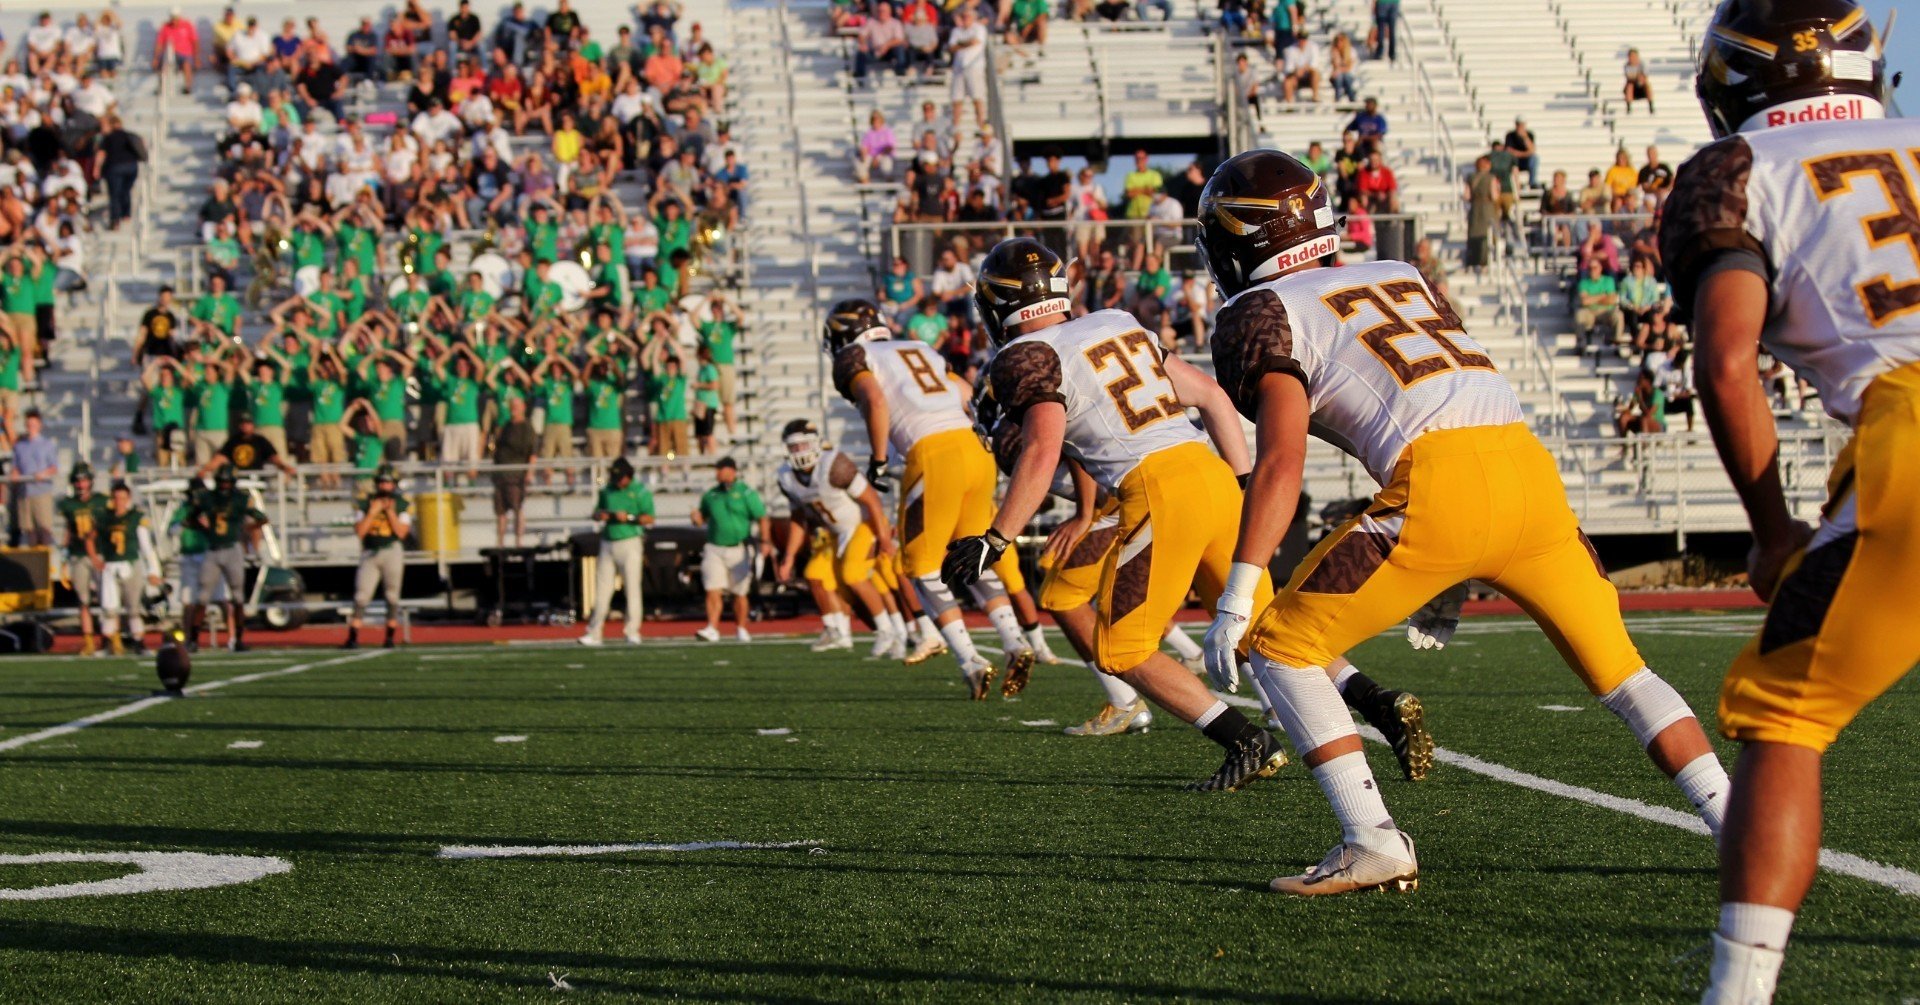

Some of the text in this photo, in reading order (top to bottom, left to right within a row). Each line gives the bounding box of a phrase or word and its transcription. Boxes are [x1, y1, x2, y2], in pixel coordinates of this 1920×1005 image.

[1792, 30, 1819, 52] 35
[1767, 99, 1863, 127] Riddell
[1277, 237, 1335, 270] Riddell
[1802, 147, 1920, 329] 3
[1026, 253, 1039, 262] 23
[1020, 300, 1065, 320] Riddell
[1320, 278, 1498, 391] 22
[896, 348, 948, 395] 8
[1083, 327, 1185, 435] 23
